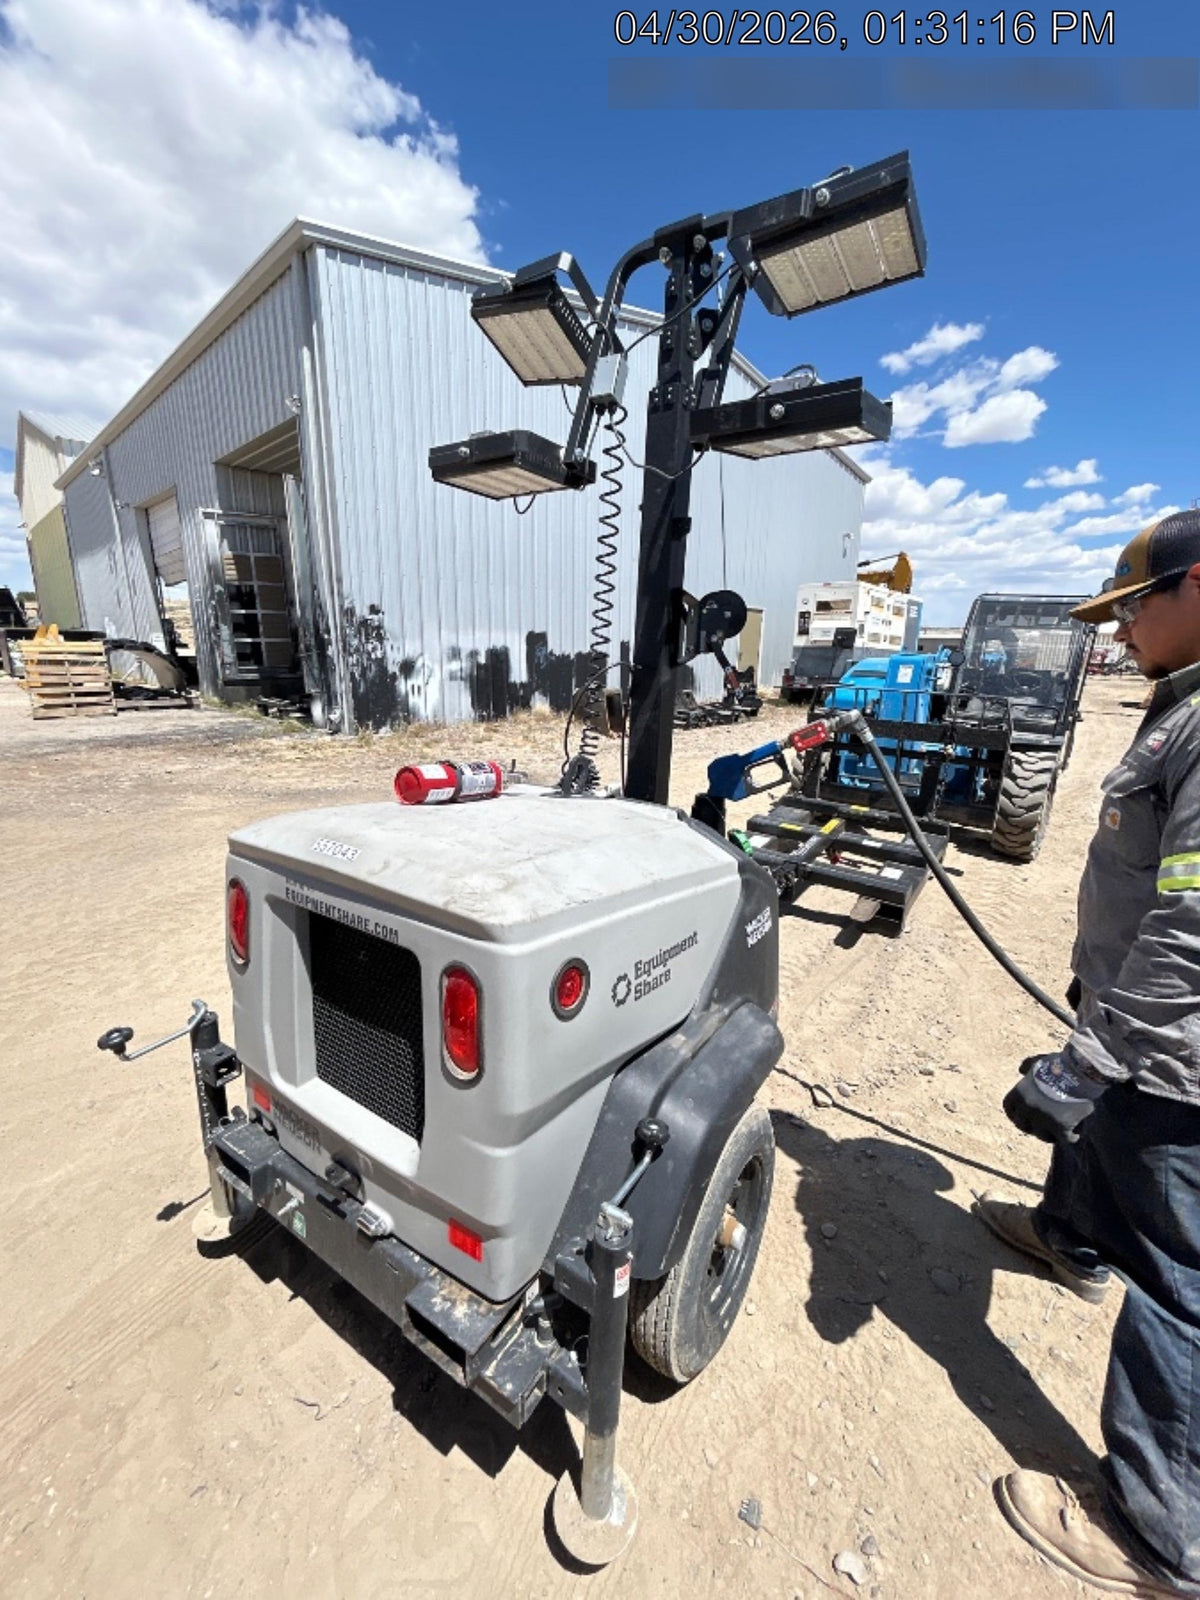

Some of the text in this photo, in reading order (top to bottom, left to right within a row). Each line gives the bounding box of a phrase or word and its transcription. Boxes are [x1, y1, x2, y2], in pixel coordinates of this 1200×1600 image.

[285, 886, 399, 944] EQUIPMENTSHARE.COM
[634, 930, 698, 981] Equipment
[634, 968, 671, 1002] Share
